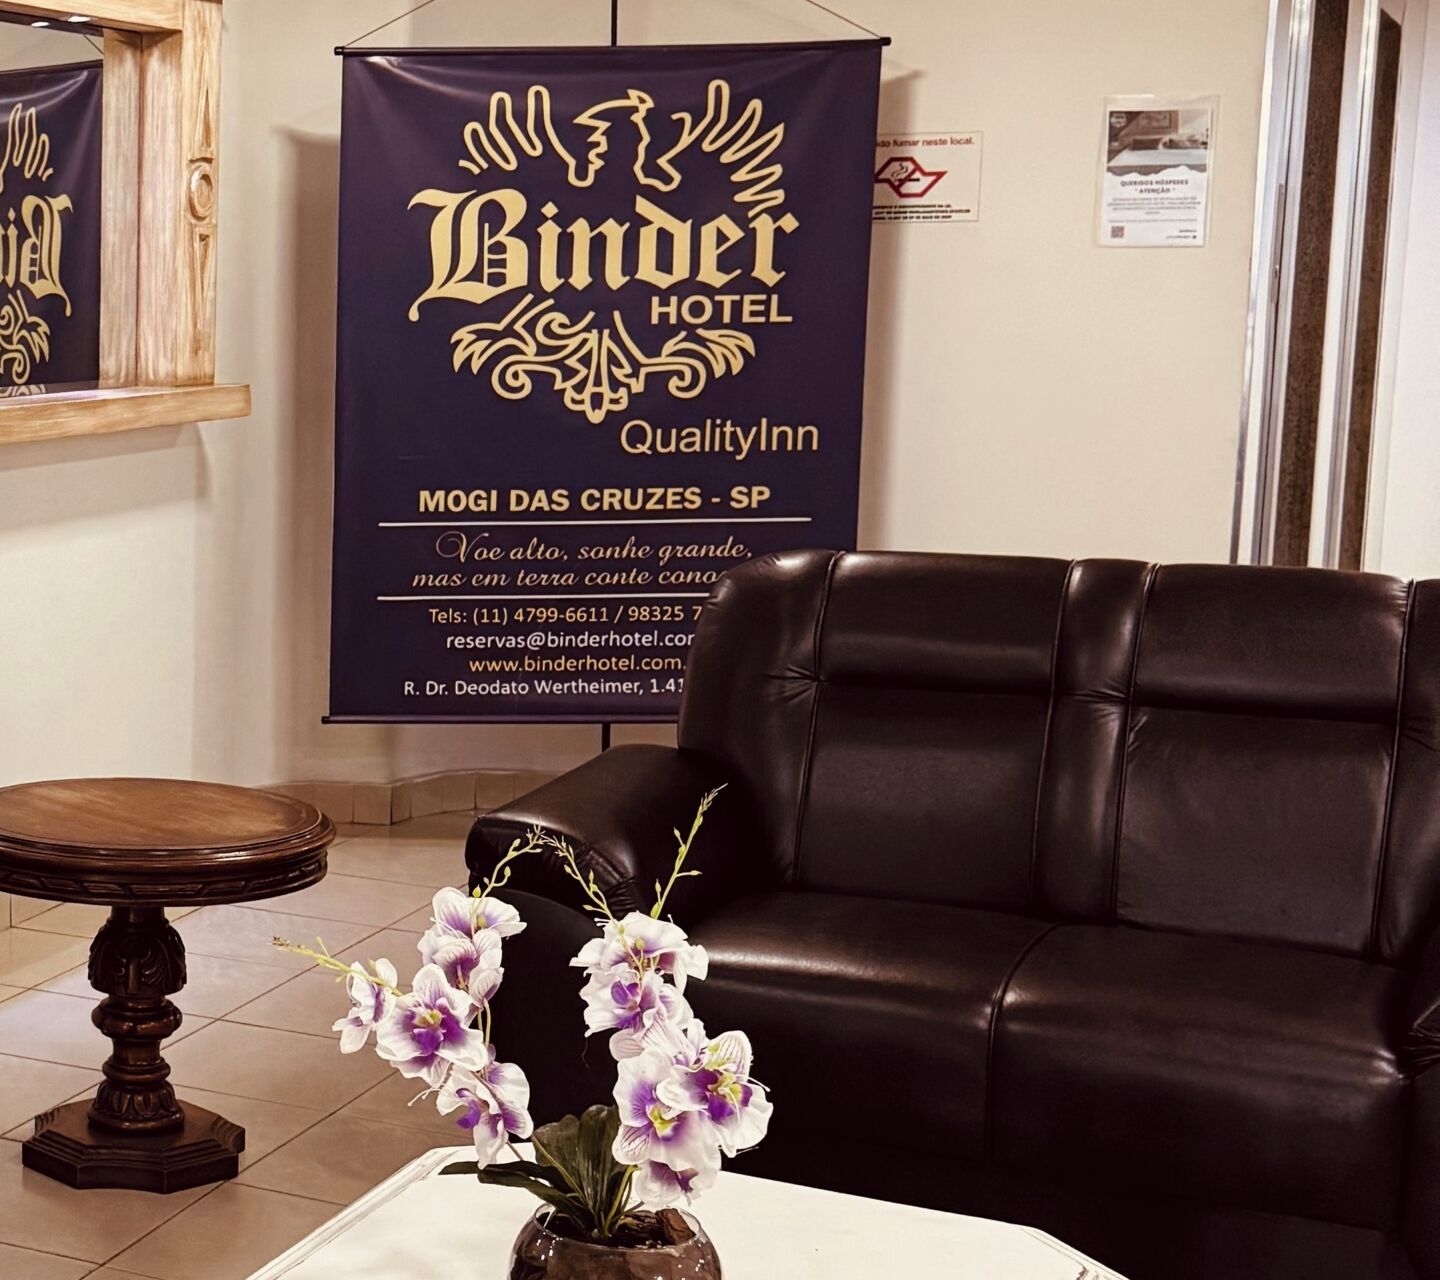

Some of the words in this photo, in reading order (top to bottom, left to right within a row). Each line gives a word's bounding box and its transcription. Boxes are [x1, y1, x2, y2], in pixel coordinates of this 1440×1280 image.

[892, 138, 920, 147] fumar
[922, 137, 948, 146] neste
[950, 136, 975, 145] local.
[407, 188, 800, 322] Binder
[650, 293, 793, 325] HOTEL
[620, 417, 819, 461] QualityInn
[418, 489, 497, 513] MOGI
[509, 488, 570, 512] DAS
[580, 486, 702, 512] CRUZES
[729, 485, 771, 509] SP
[436, 531, 505, 564] Voe
[509, 537, 569, 562] alto,
[577, 535, 654, 560] sonhe
[658, 535, 753, 567] grande,
[412, 570, 465, 588] mas
[471, 570, 512, 587] em
[516, 567, 579, 587] terra
[584, 566, 654, 586] conte
[658, 570, 728, 584] cono
[428, 608, 467, 624] Tels:
[473, 607, 509, 626] (11)
[513, 607, 609, 623] 4799-6611
[628, 605, 685, 621] 98325
[403, 681, 420, 696] R.
[425, 680, 449, 696] Dr.
[454, 678, 530, 695] Deodato
[534, 677, 644, 696] Wertheimer,
